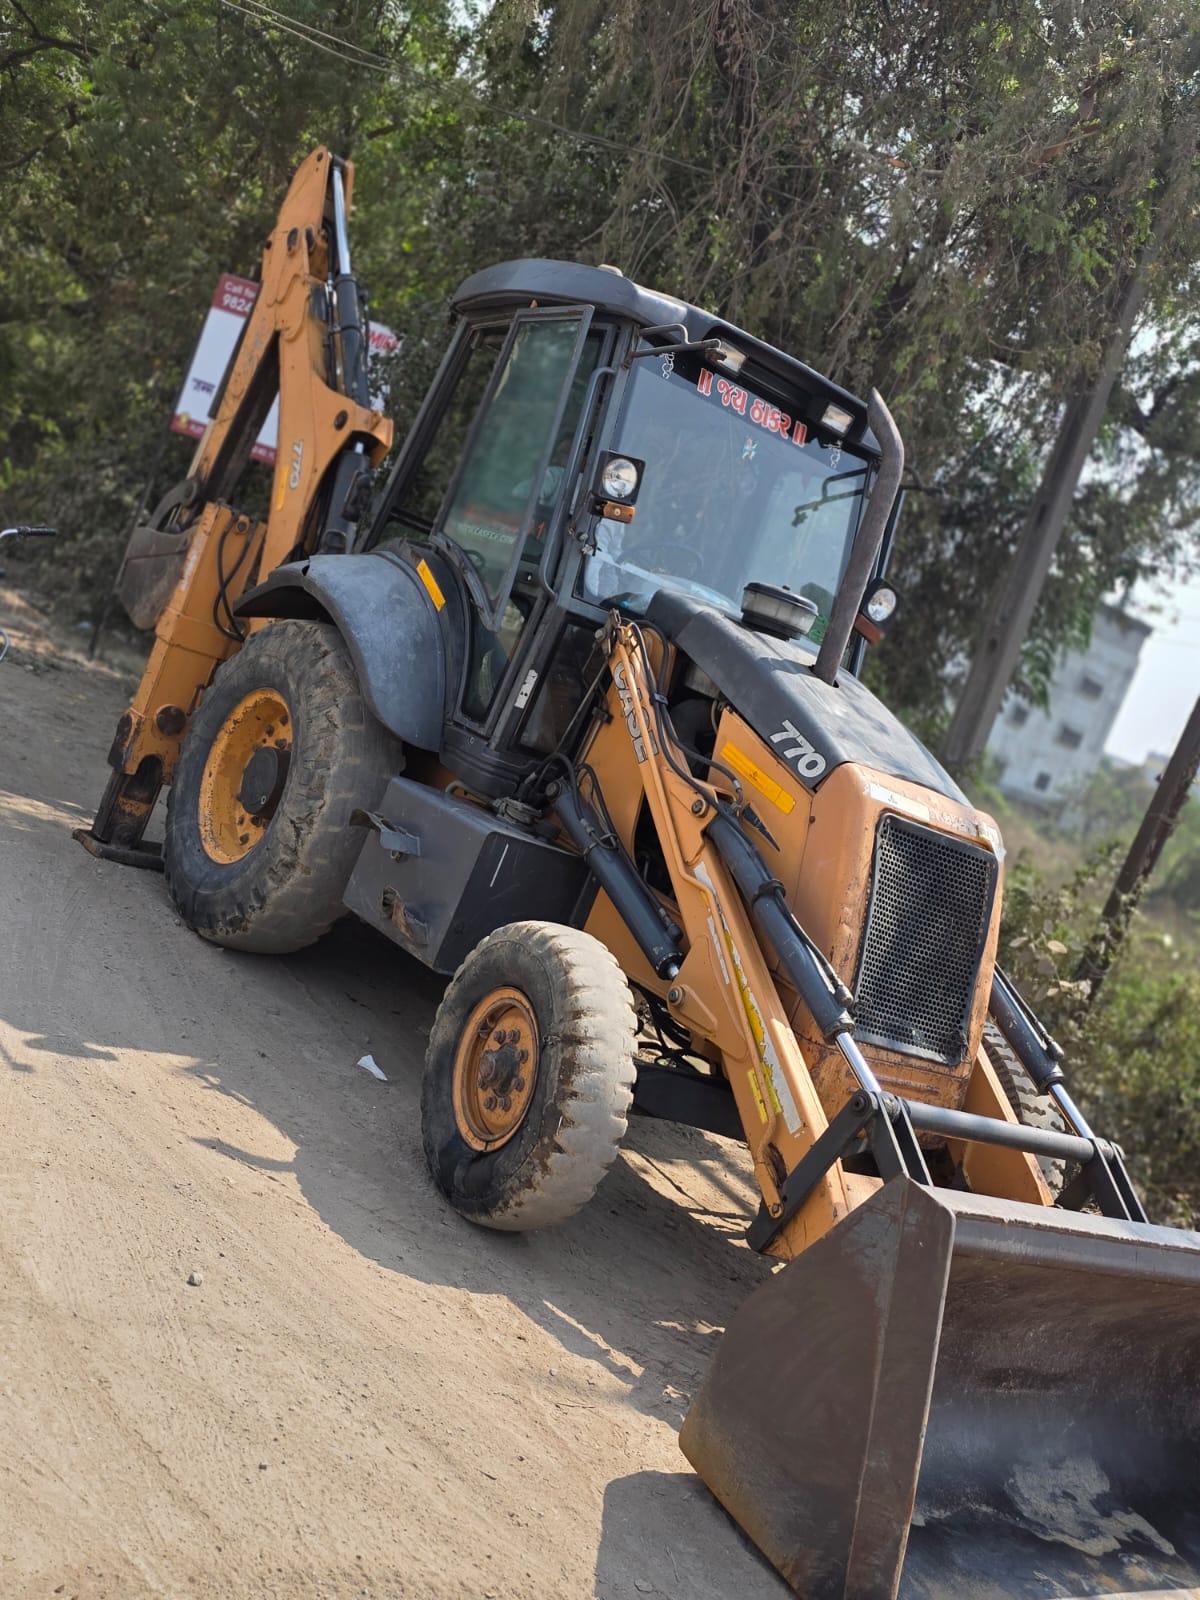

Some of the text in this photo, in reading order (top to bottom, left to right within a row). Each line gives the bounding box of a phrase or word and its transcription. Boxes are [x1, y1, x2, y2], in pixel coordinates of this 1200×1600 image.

[717, 379, 748, 416] જય
[750, 399, 792, 440] ઠાકર
[289, 438, 304, 490] 770
[613, 660, 660, 764] CASE
[769, 719, 827, 778] 770
